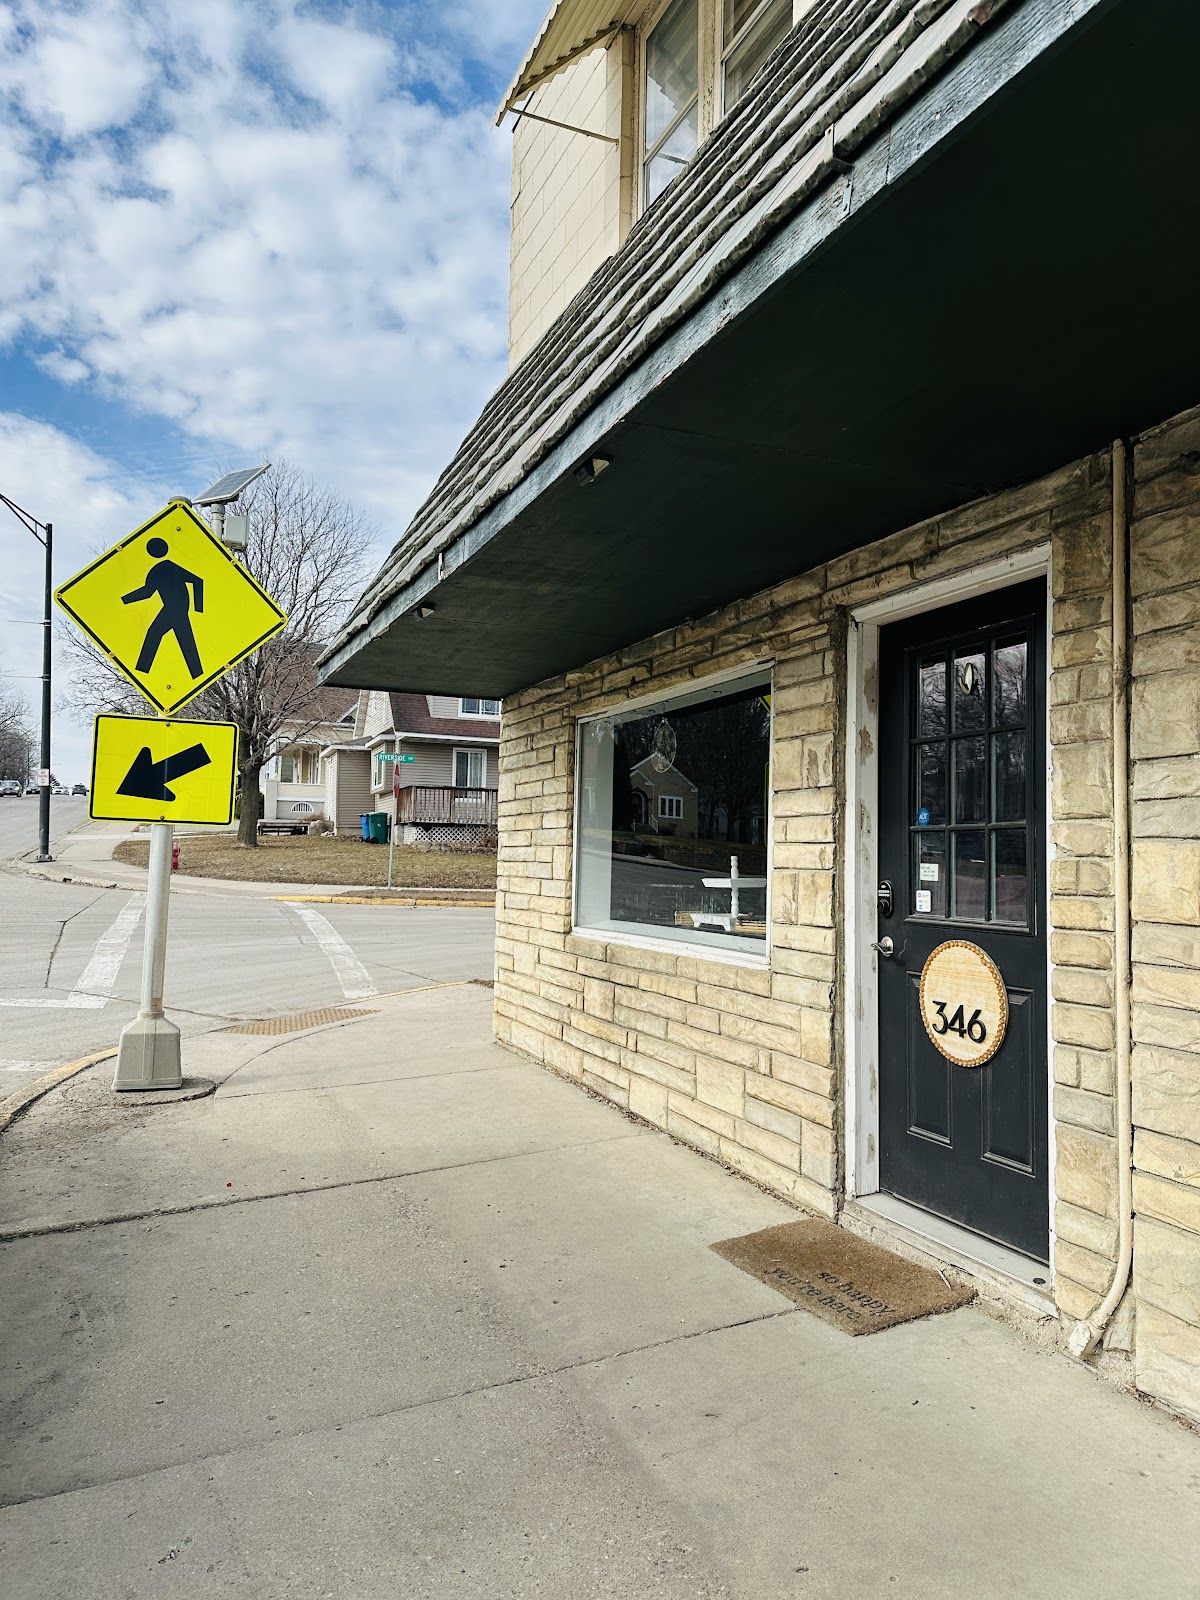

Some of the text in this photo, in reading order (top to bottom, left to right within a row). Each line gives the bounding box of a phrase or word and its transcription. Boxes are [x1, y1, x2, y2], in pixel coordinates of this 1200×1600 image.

[379, 753, 406, 762] RIVERSIDE
[918, 812, 928, 820] ADT
[932, 1000, 987, 1044] 346
[764, 1267, 862, 1321] you're here
[815, 1271, 896, 1317] so happy
